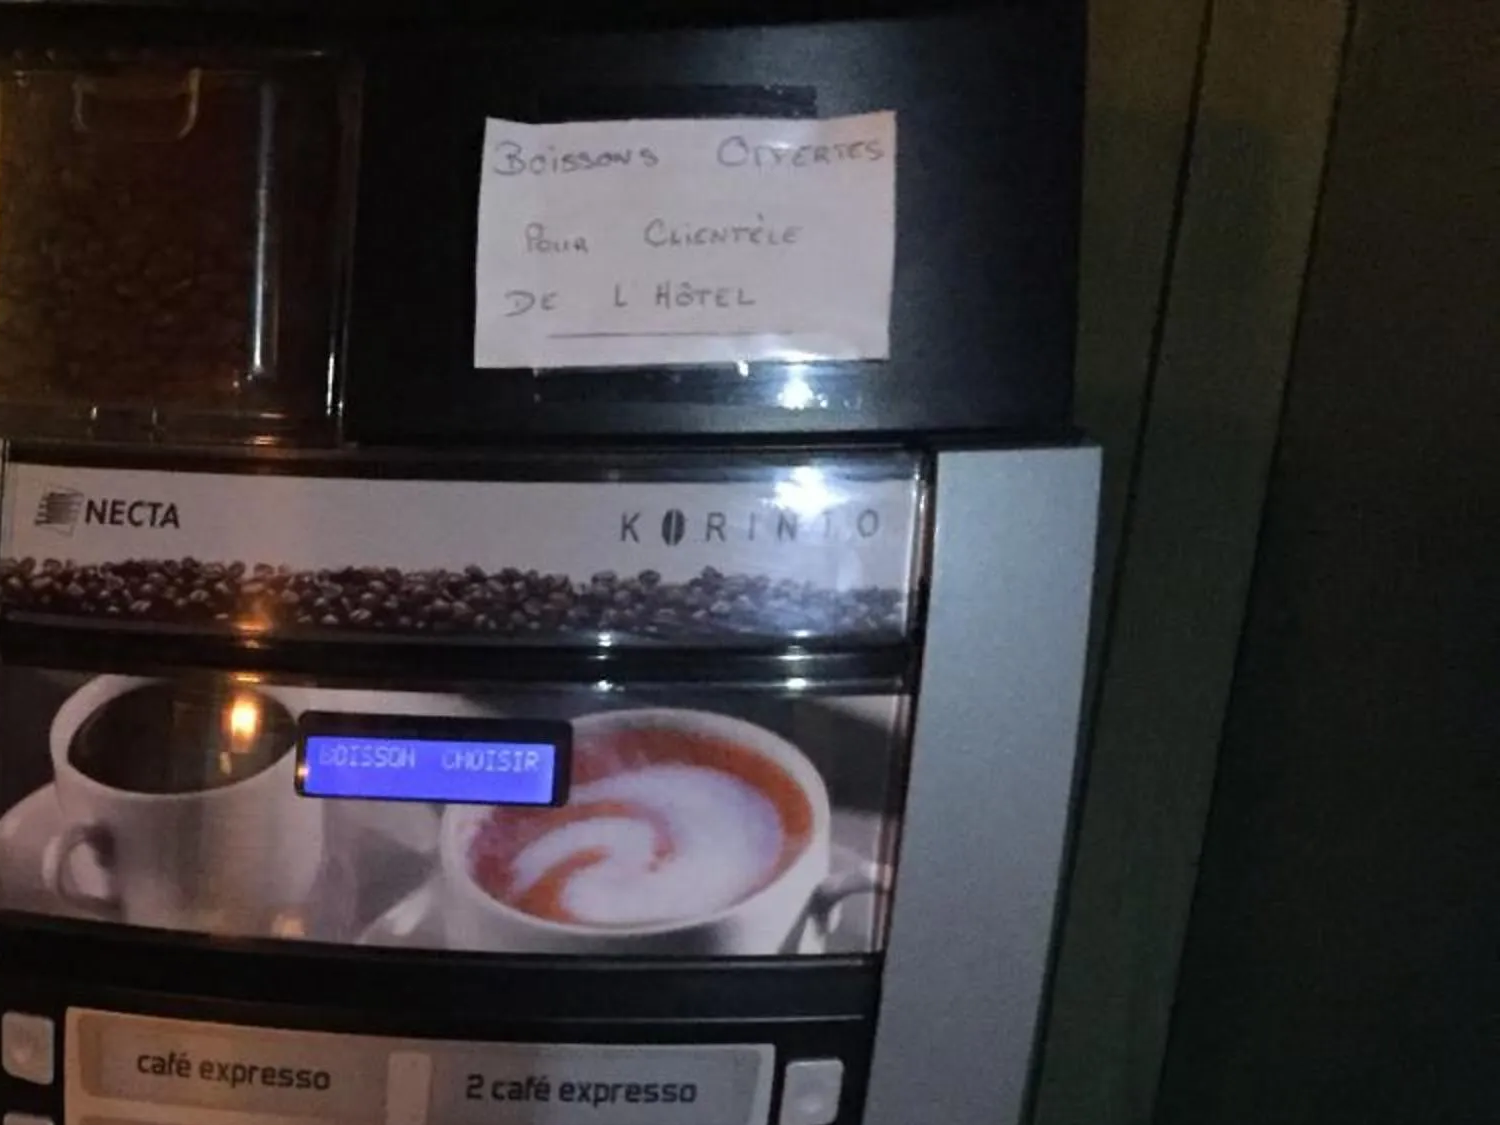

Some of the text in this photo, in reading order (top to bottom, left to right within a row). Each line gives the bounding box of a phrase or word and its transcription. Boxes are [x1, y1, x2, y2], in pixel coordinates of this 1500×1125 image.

[493, 140, 659, 177] BOISSONS
[523, 221, 590, 255] POUR
[503, 289, 561, 318] DE
[84, 498, 181, 529] NECTA
[136, 1051, 332, 1091] café expresso
[466, 1074, 699, 1108] 2 café expresso
